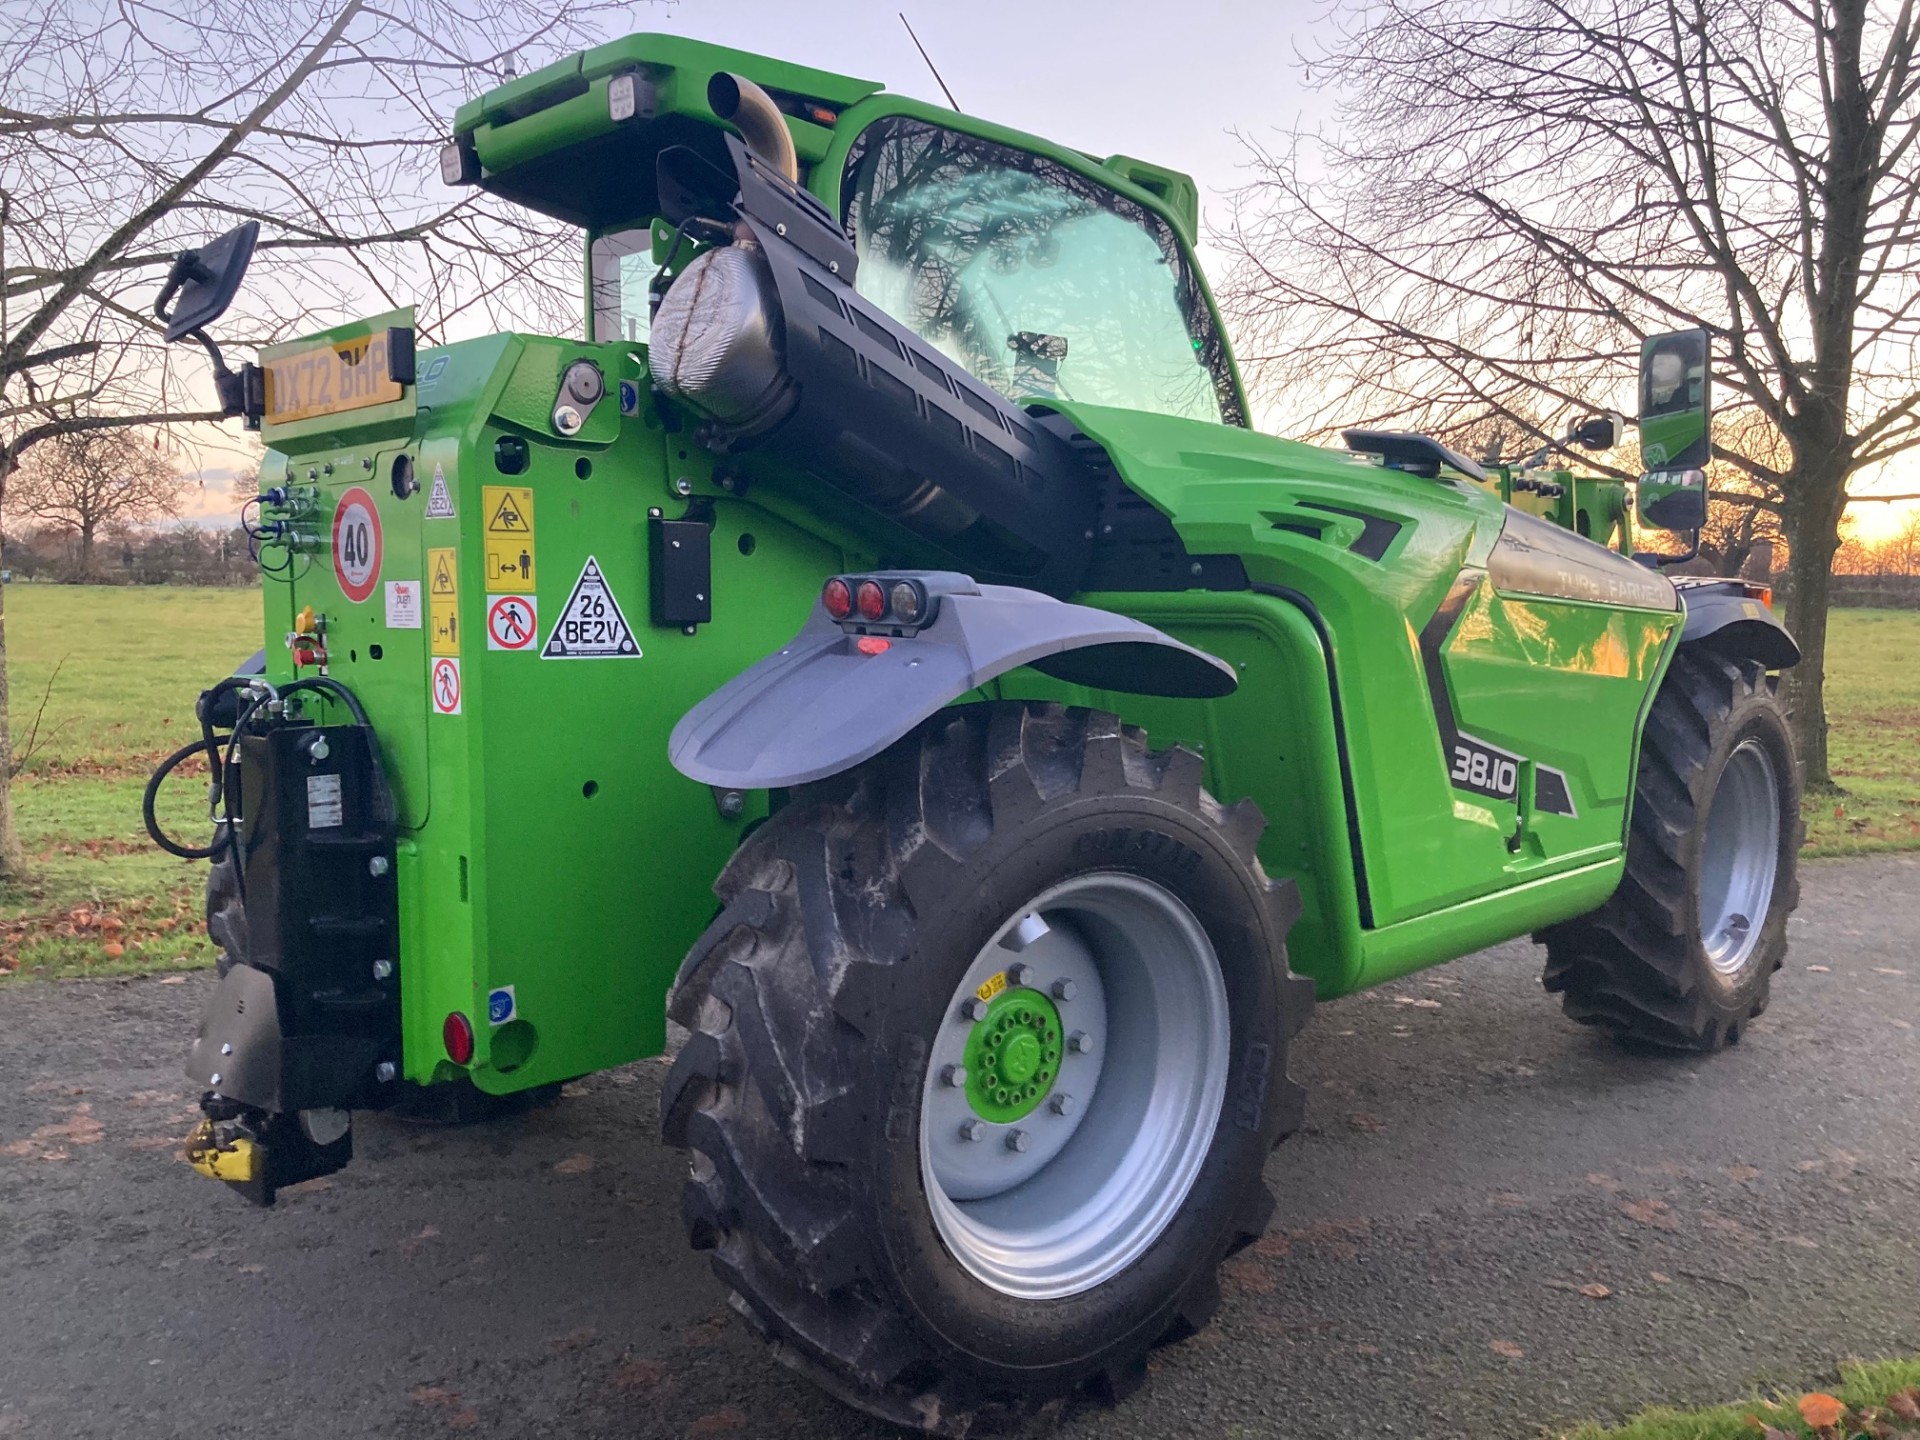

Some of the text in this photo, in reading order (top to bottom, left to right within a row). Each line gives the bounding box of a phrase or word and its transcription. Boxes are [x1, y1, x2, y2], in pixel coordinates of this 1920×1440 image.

[272, 341, 387, 415] DX72 BHP
[435, 483, 444, 496] 26
[431, 497, 448, 510] BE2V
[344, 522, 369, 567] 40
[580, 594, 605, 618] 26
[565, 621, 619, 644] BE2V
[1451, 745, 1517, 794] 38.10
